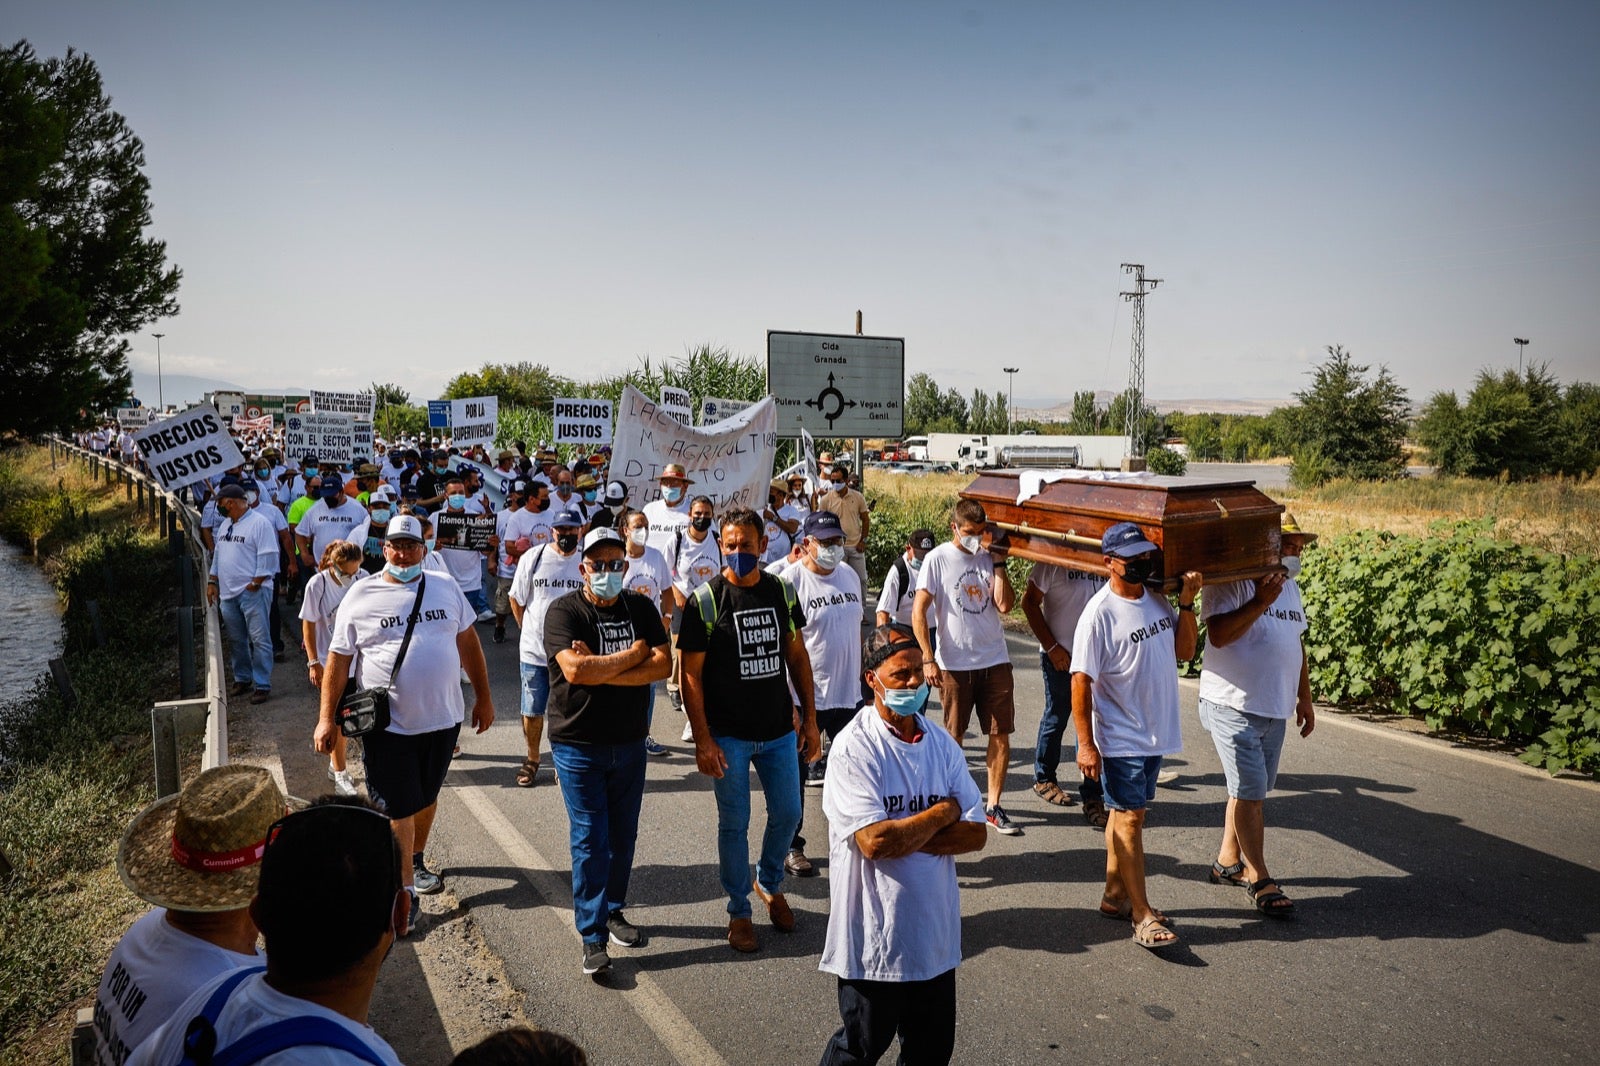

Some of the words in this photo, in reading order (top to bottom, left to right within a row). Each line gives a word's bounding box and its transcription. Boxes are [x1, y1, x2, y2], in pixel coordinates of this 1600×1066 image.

[814, 354, 847, 364] Granada
[775, 397, 800, 406] Puleva
[860, 400, 882, 410] Vegas
[886, 400, 898, 409] del
[465, 403, 477, 419] POR
[478, 402, 486, 417] LA
[556, 403, 609, 419] PRECIOS
[869, 412, 889, 420] Genil
[136, 414, 219, 458] PRECIOS
[354, 434, 371, 443] PARA
[453, 422, 494, 442] SUPERVIVENCIA
[558, 423, 602, 440] JUSTOS
[287, 433, 304, 446] CON
[308, 434, 318, 446] EL
[322, 435, 351, 448] SECTOR
[287, 447, 316, 459] LACTEO
[318, 447, 351, 461] ESPAÑOL
[156, 445, 223, 488] JUSTOS
[1068, 571, 1086, 580] OPL
[534, 578, 550, 588] OPL
[552, 579, 565, 588] del
[810, 596, 830, 610] OPL
[830, 593, 844, 606] del
[380, 615, 404, 629] OPL
[425, 609, 448, 622] SUR
[742, 616, 760, 628] CON
[761, 614, 772, 625] LA
[1276, 609, 1287, 620] del
[1289, 609, 1302, 623] SUR
[618, 627, 629, 638] LA
[742, 627, 776, 645] LECHE
[1130, 628, 1150, 644] OPL
[1149, 622, 1160, 636] del
[1160, 617, 1173, 630] SUR
[756, 646, 767, 657] AL
[740, 655, 780, 675] CUELLO
[203, 857, 245, 866] Cummins
[107, 962, 130, 1005] POR
[122, 983, 147, 1022] UN
